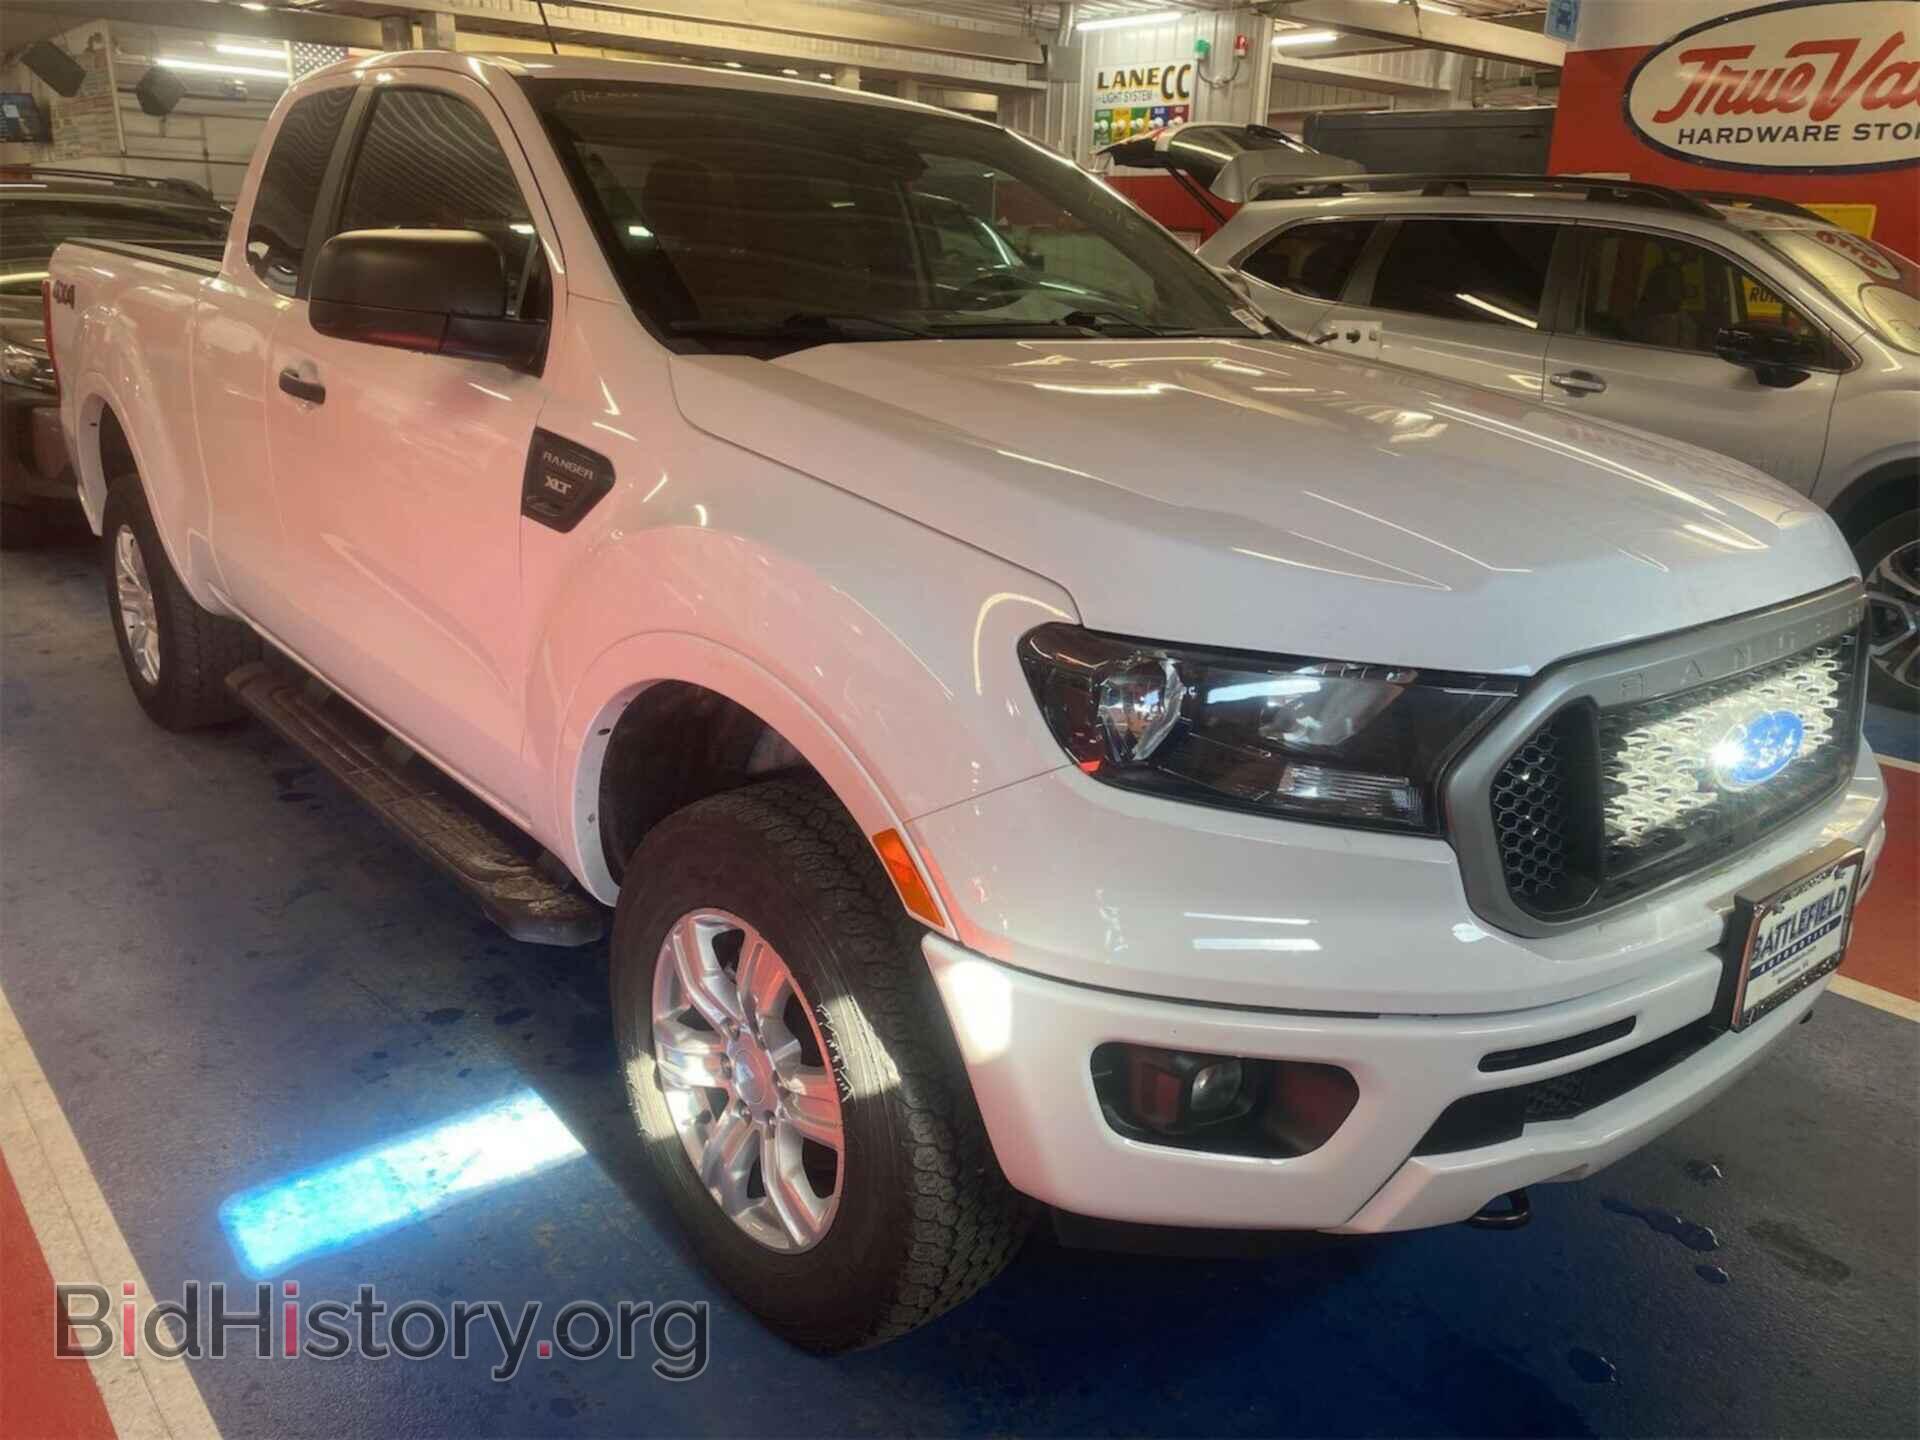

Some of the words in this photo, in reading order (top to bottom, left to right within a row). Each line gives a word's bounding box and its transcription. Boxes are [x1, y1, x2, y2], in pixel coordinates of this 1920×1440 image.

[1097, 67, 1160, 89] LANE
[1161, 64, 1191, 100] CC
[1123, 89, 1153, 102] SYSTEM
[1677, 124, 1841, 145] HARDWARE
[543, 450, 594, 480] RANGER
[544, 475, 572, 495] XLT
[1752, 884, 1848, 962] BATTLEFIELD
